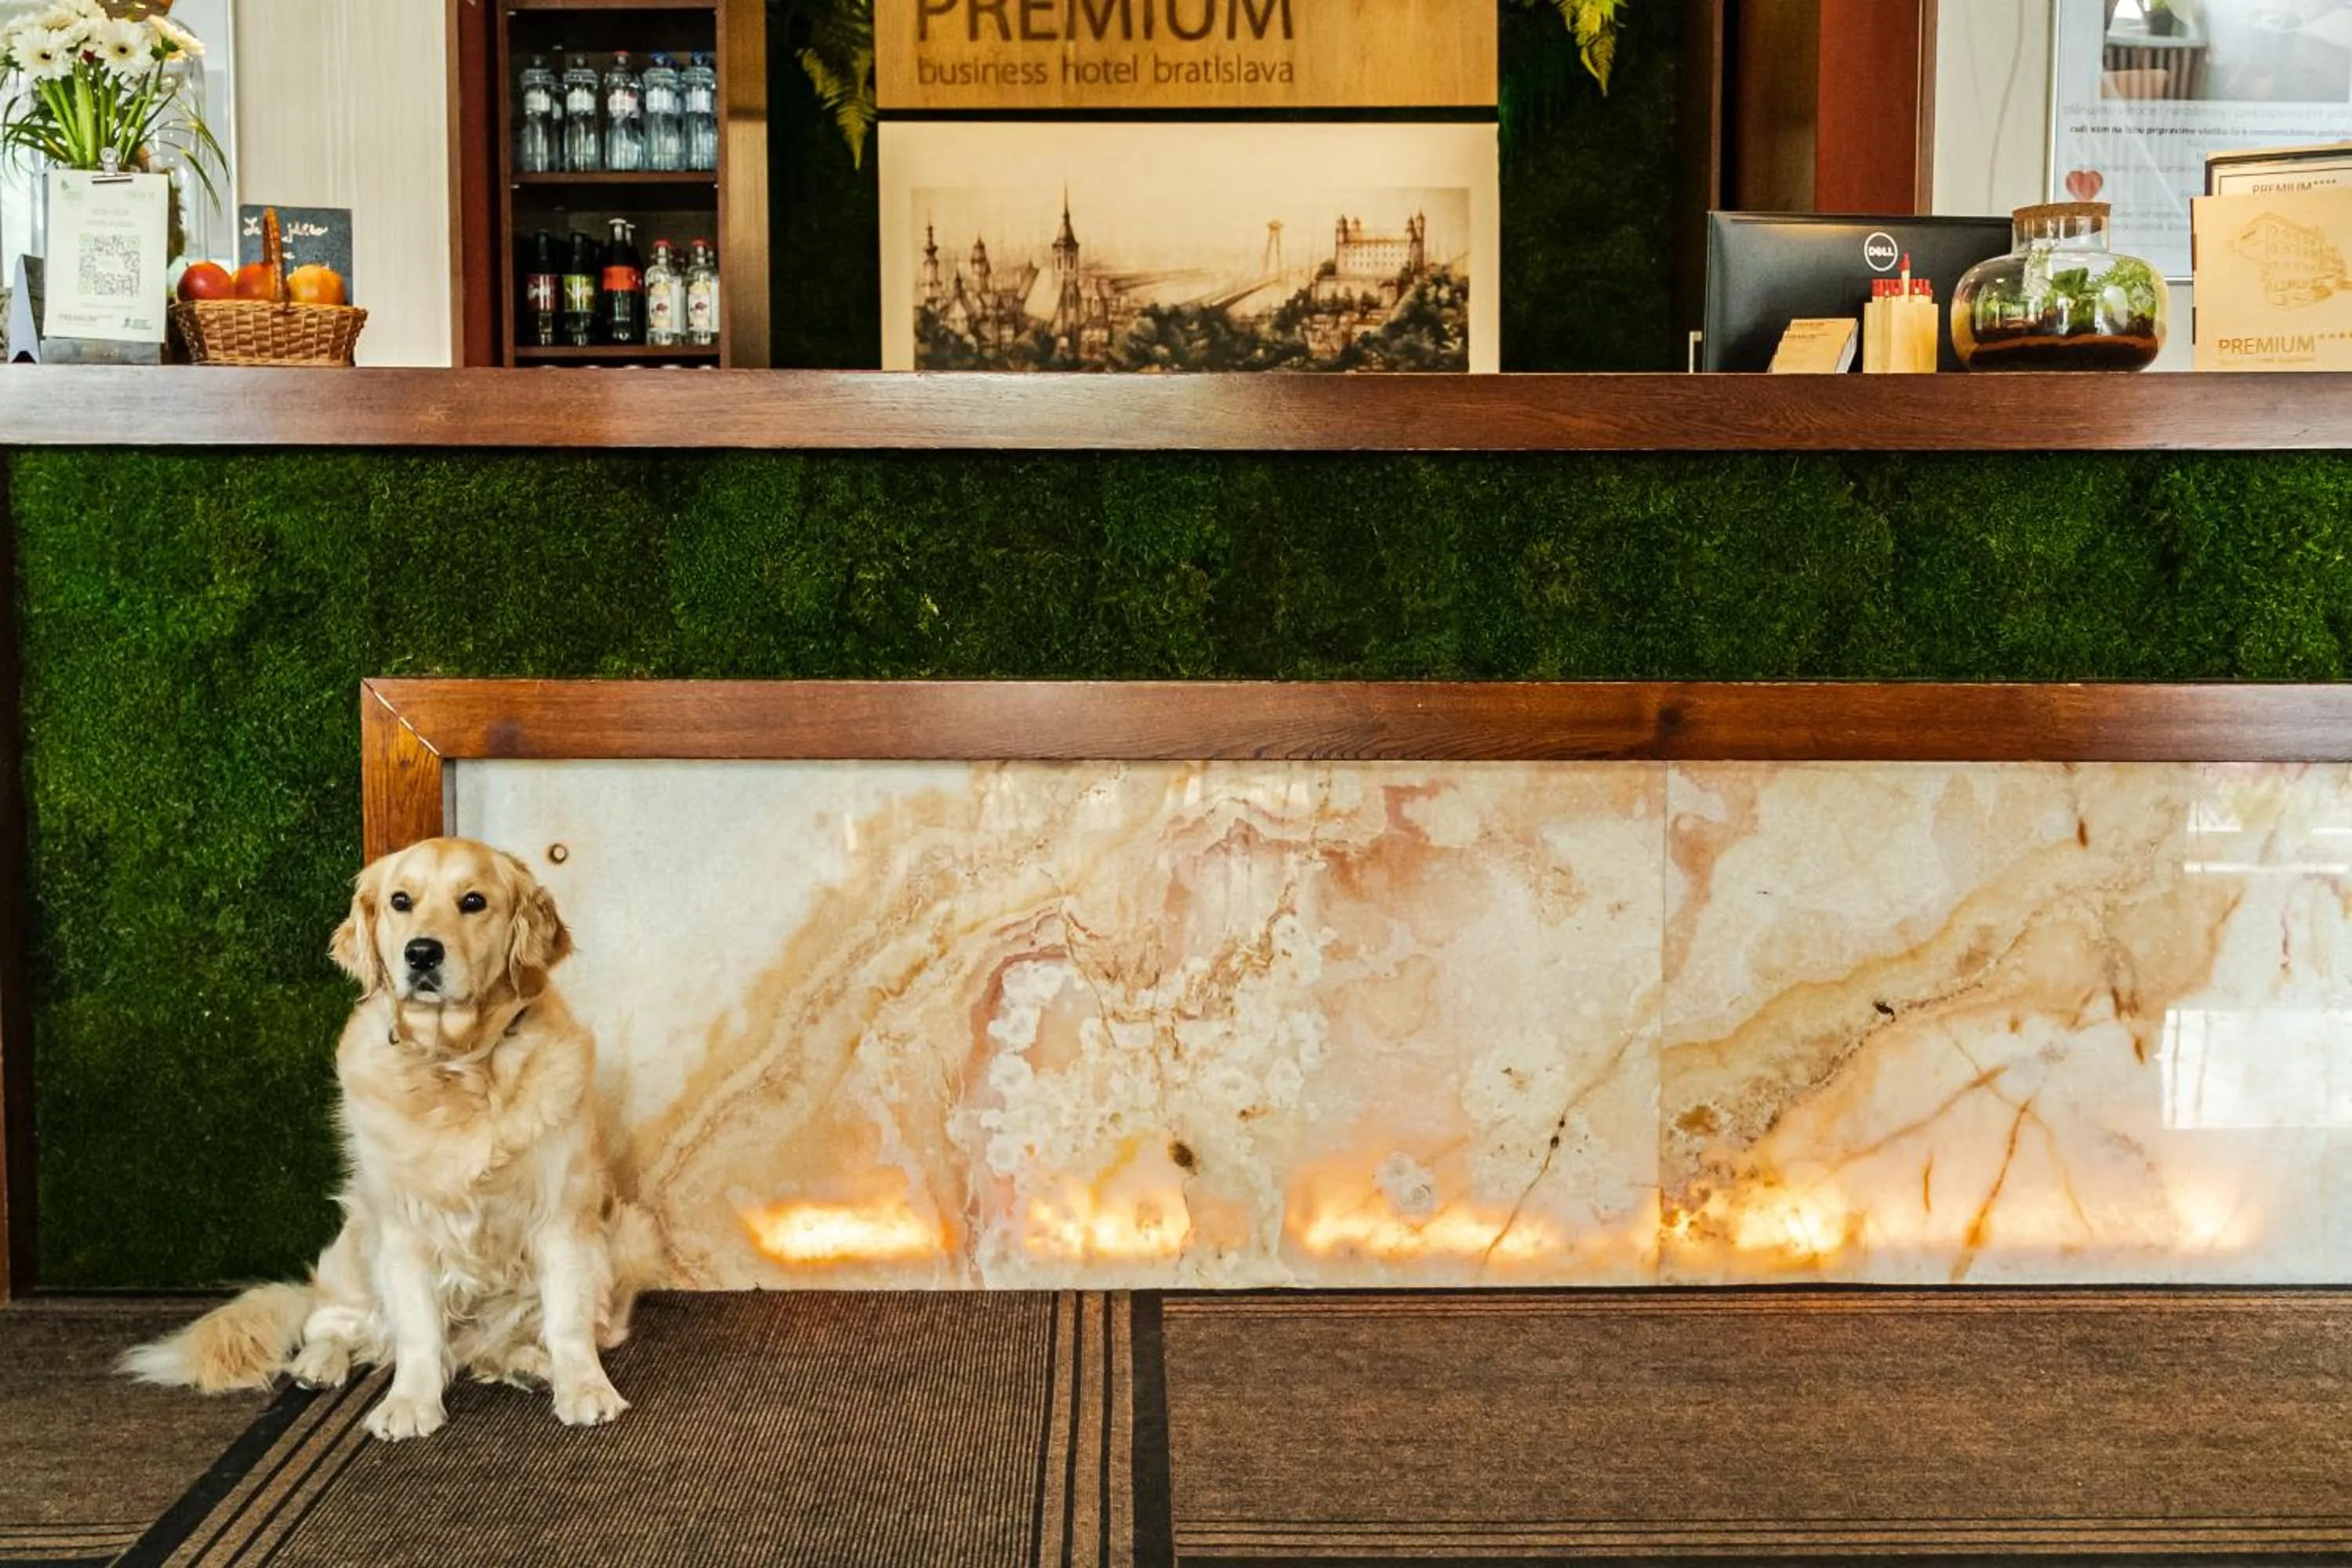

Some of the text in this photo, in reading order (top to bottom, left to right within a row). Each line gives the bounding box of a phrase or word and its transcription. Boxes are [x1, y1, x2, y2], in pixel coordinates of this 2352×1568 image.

[917, 0, 1294, 42] PREMIUM
[917, 55, 1294, 85] business hotel bratislava
[1868, 245, 1894, 256] DELL
[2218, 336, 2315, 355] PREMIUM
